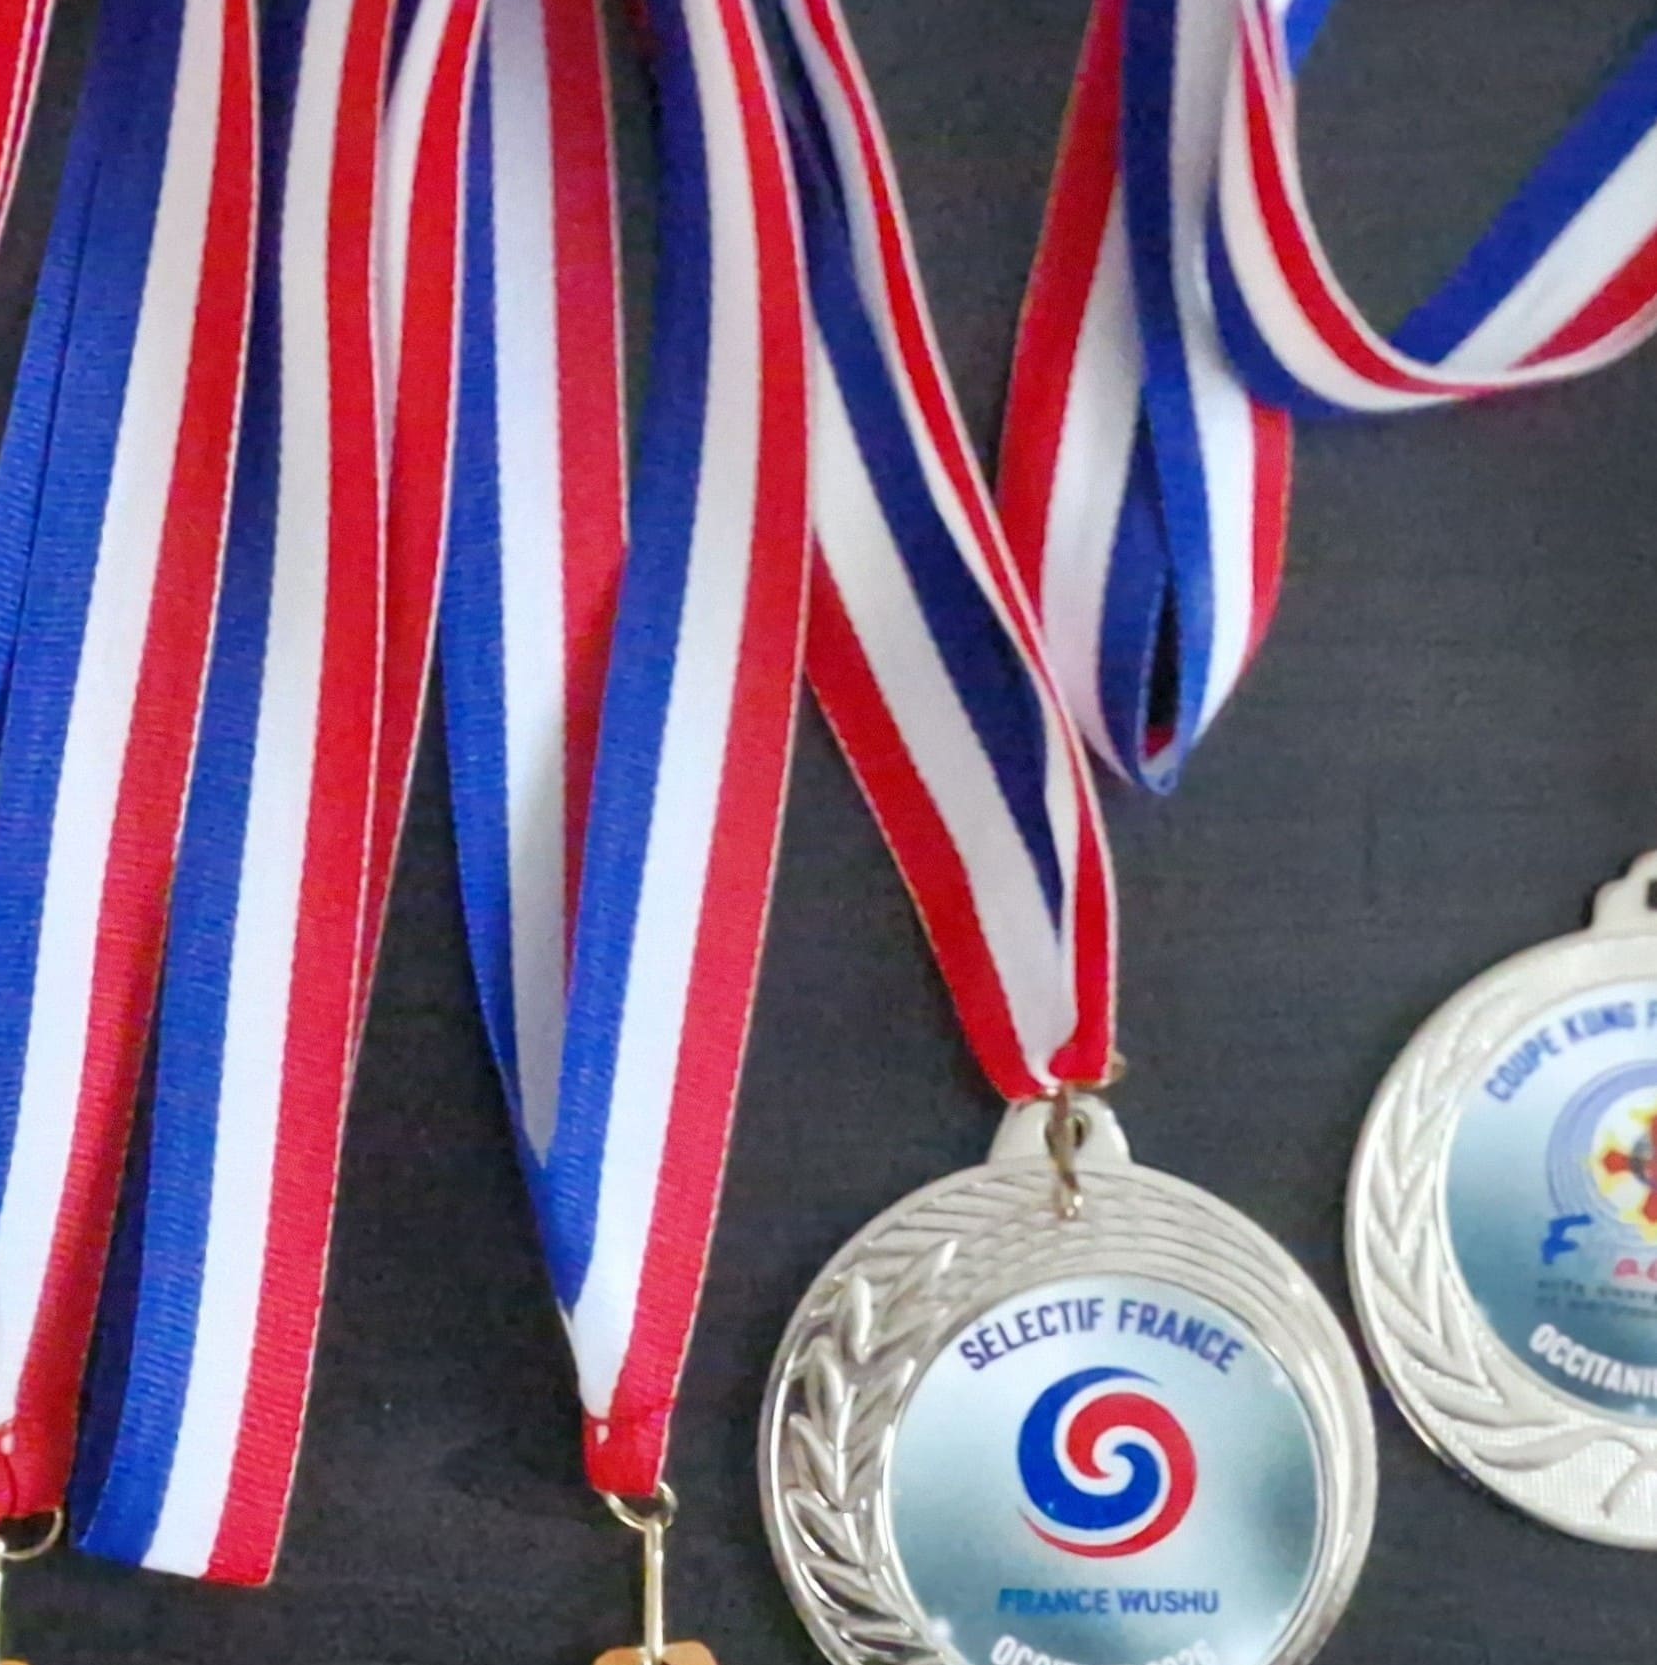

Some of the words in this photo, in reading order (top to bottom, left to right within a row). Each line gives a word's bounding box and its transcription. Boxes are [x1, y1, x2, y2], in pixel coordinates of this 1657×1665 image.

[1484, 1024, 1562, 1102] COUPE
[1560, 1000, 1637, 1045] KUNG
[1116, 1297, 1247, 1376] FRANCE
[997, 1586, 1112, 1615] FRANCE
[1117, 1587, 1220, 1615] WUSHU
